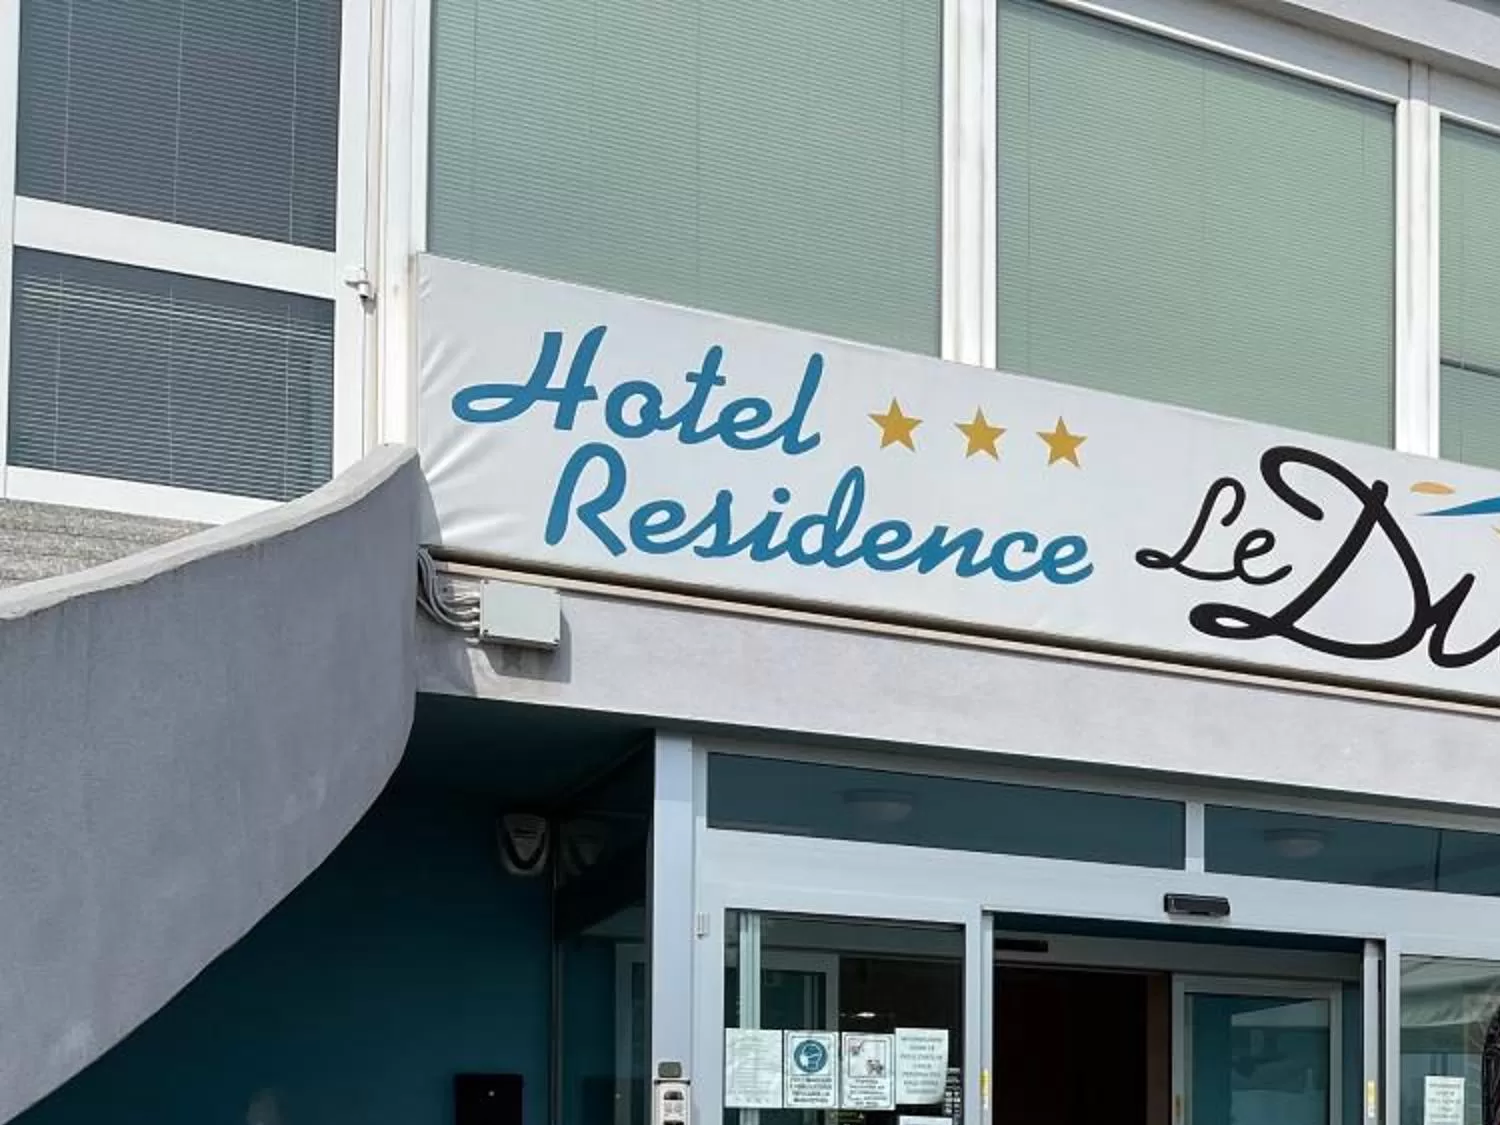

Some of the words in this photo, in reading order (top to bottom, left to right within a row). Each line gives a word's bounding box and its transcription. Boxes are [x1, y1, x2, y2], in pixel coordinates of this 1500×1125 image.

[451, 326, 826, 458] Hotel
[543, 441, 1092, 586] Residence
[1134, 476, 1294, 587] Le
